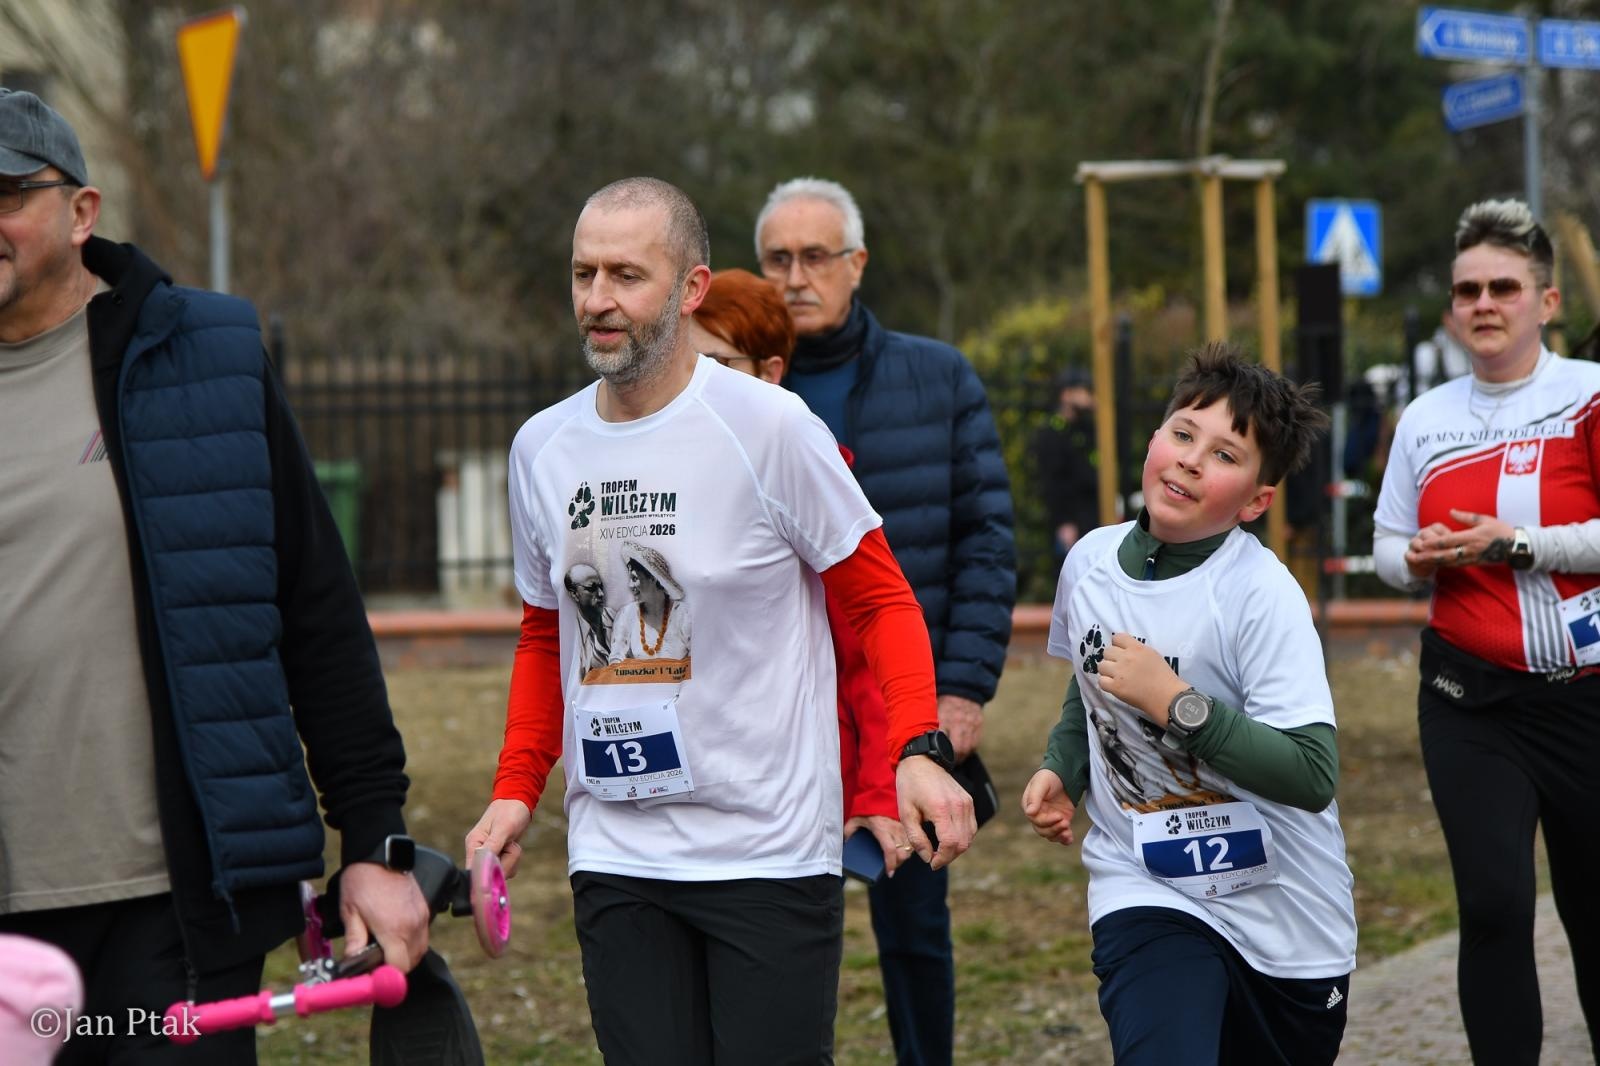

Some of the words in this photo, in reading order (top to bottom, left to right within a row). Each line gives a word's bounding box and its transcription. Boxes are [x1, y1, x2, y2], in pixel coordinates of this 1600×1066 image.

[601, 479, 637, 494] TROPEM
[601, 493, 677, 516] WILCZYM
[600, 527, 615, 540] XIV
[616, 525, 648, 539] EDYCJA
[649, 523, 676, 536] 2026
[1432, 674, 1464, 699] HARD
[604, 721, 642, 734] WILCZYM
[604, 740, 648, 774] 13
[640, 772, 666, 782] EDYCJA
[667, 769, 683, 778] 2026
[1184, 810, 1208, 820] TROPEM
[1186, 815, 1231, 831] WILCZYM
[1183, 836, 1234, 873] 12
[1207, 874, 1220, 882] XIV
[1221, 869, 1250, 880] EDYCJA
[1250, 864, 1268, 874] 2026
